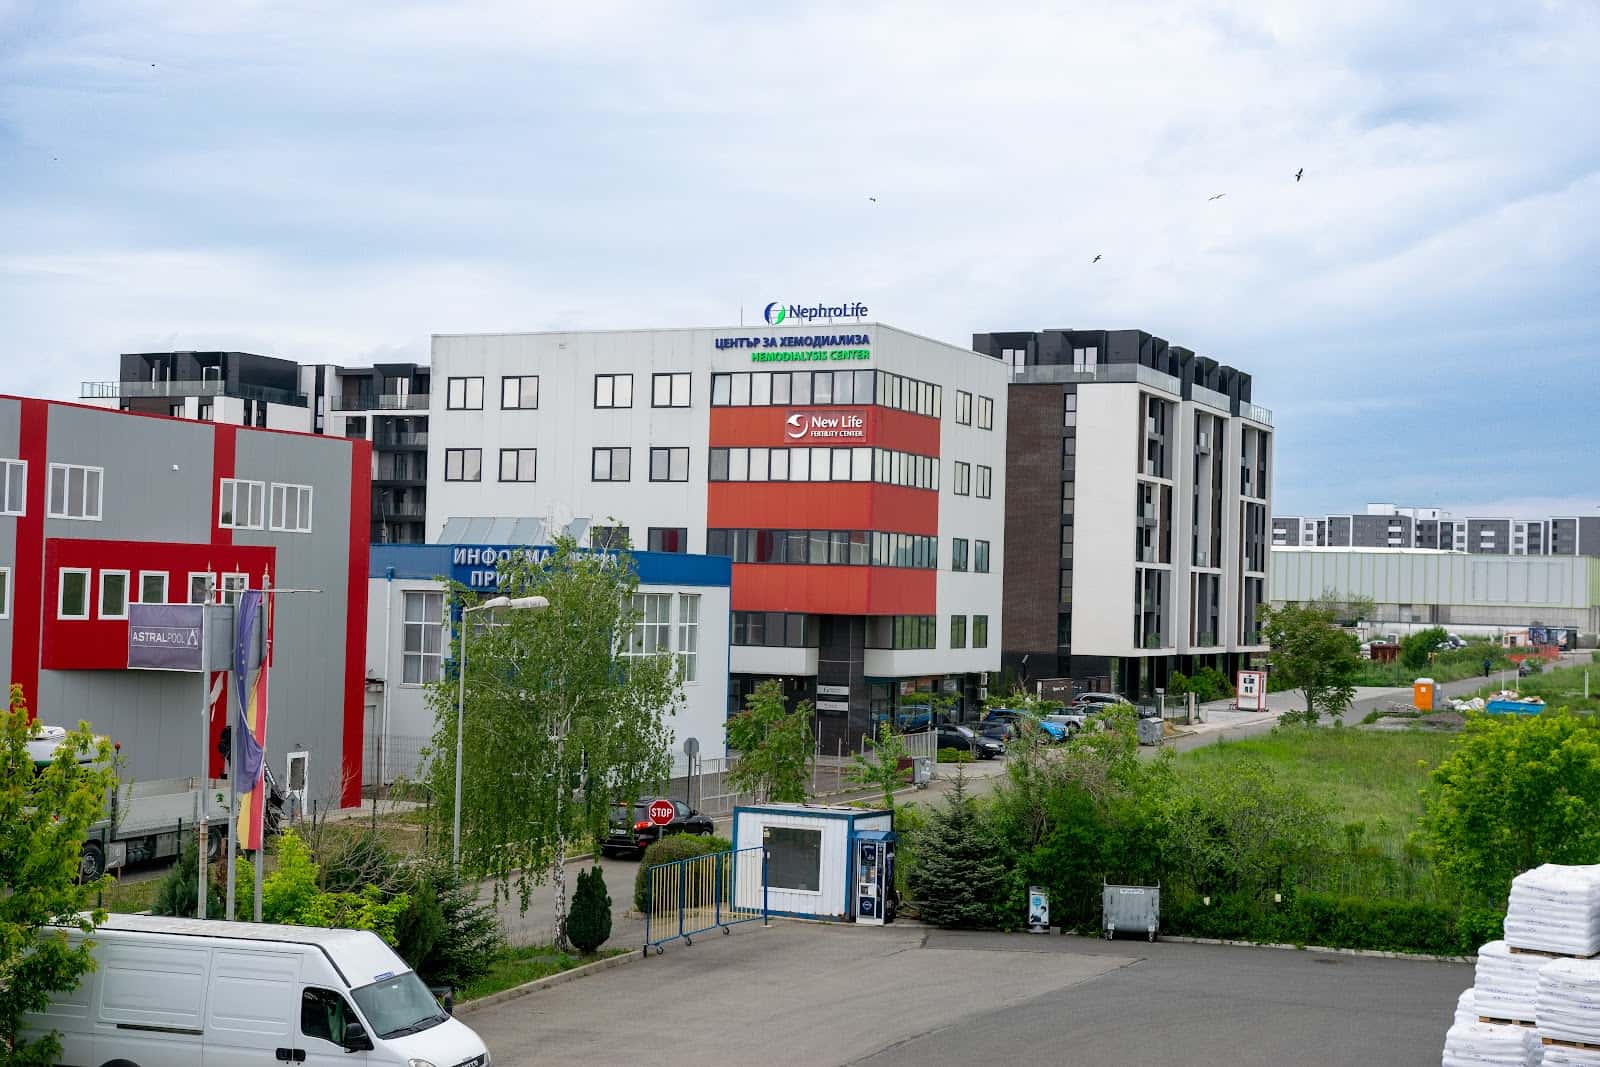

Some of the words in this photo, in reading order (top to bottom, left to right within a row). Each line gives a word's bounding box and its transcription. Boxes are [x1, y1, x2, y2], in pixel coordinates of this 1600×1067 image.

[790, 302, 868, 321] NephroLife
[715, 337, 760, 350] ЦЕНТЪР
[762, 337, 778, 348] ЗА
[780, 334, 870, 349] ХЕМОДИАЛИЗА
[752, 351, 827, 362] HEMODIALYSIS
[830, 350, 870, 361] CENTER
[811, 416, 838, 428] New
[841, 415, 863, 428] Life
[651, 808, 673, 818] STOP
